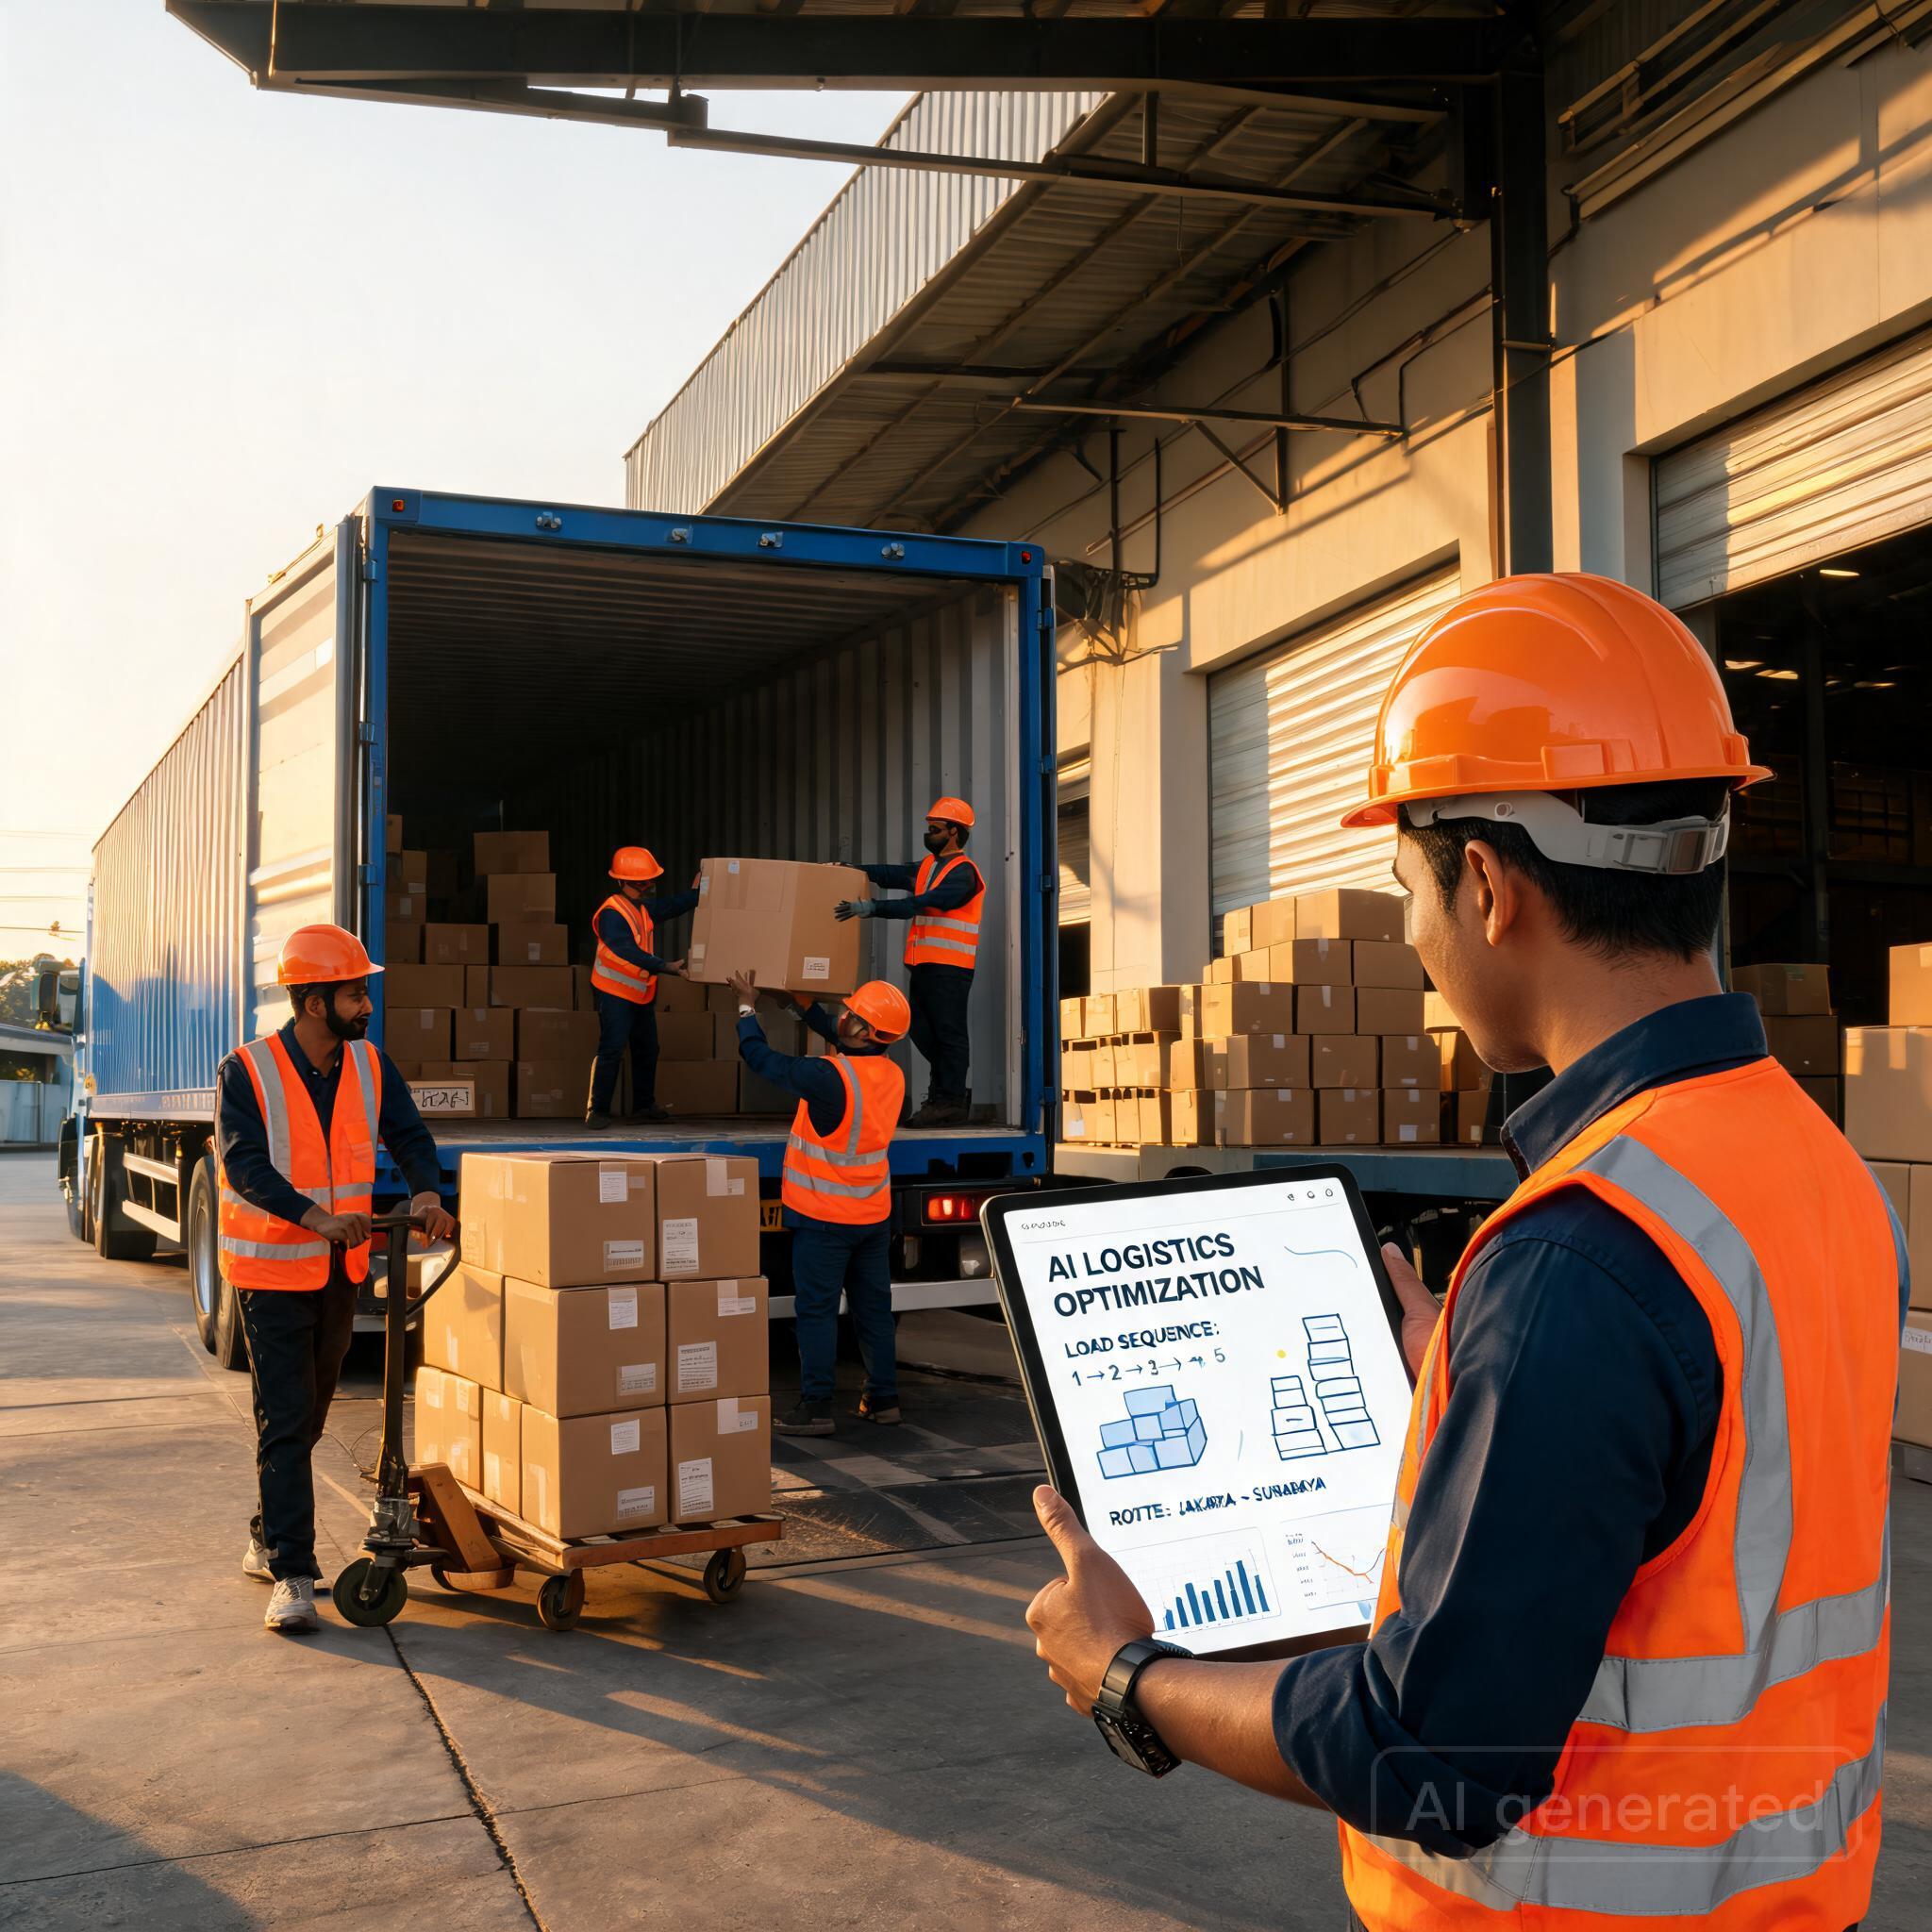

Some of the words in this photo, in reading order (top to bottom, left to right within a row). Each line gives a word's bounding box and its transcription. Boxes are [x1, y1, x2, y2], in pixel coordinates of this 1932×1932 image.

[1048, 1255, 1078, 1282] AI
[1083, 1232, 1235, 1276] LOGISTICS
[1054, 1265, 1265, 1317] OPTIMIZATION
[1064, 1336, 1114, 1358] LOAD
[1117, 1321, 1221, 1349] SEQUENCE:
[1108, 1364, 1123, 1381] 2
[1213, 1347, 1226, 1363] 5
